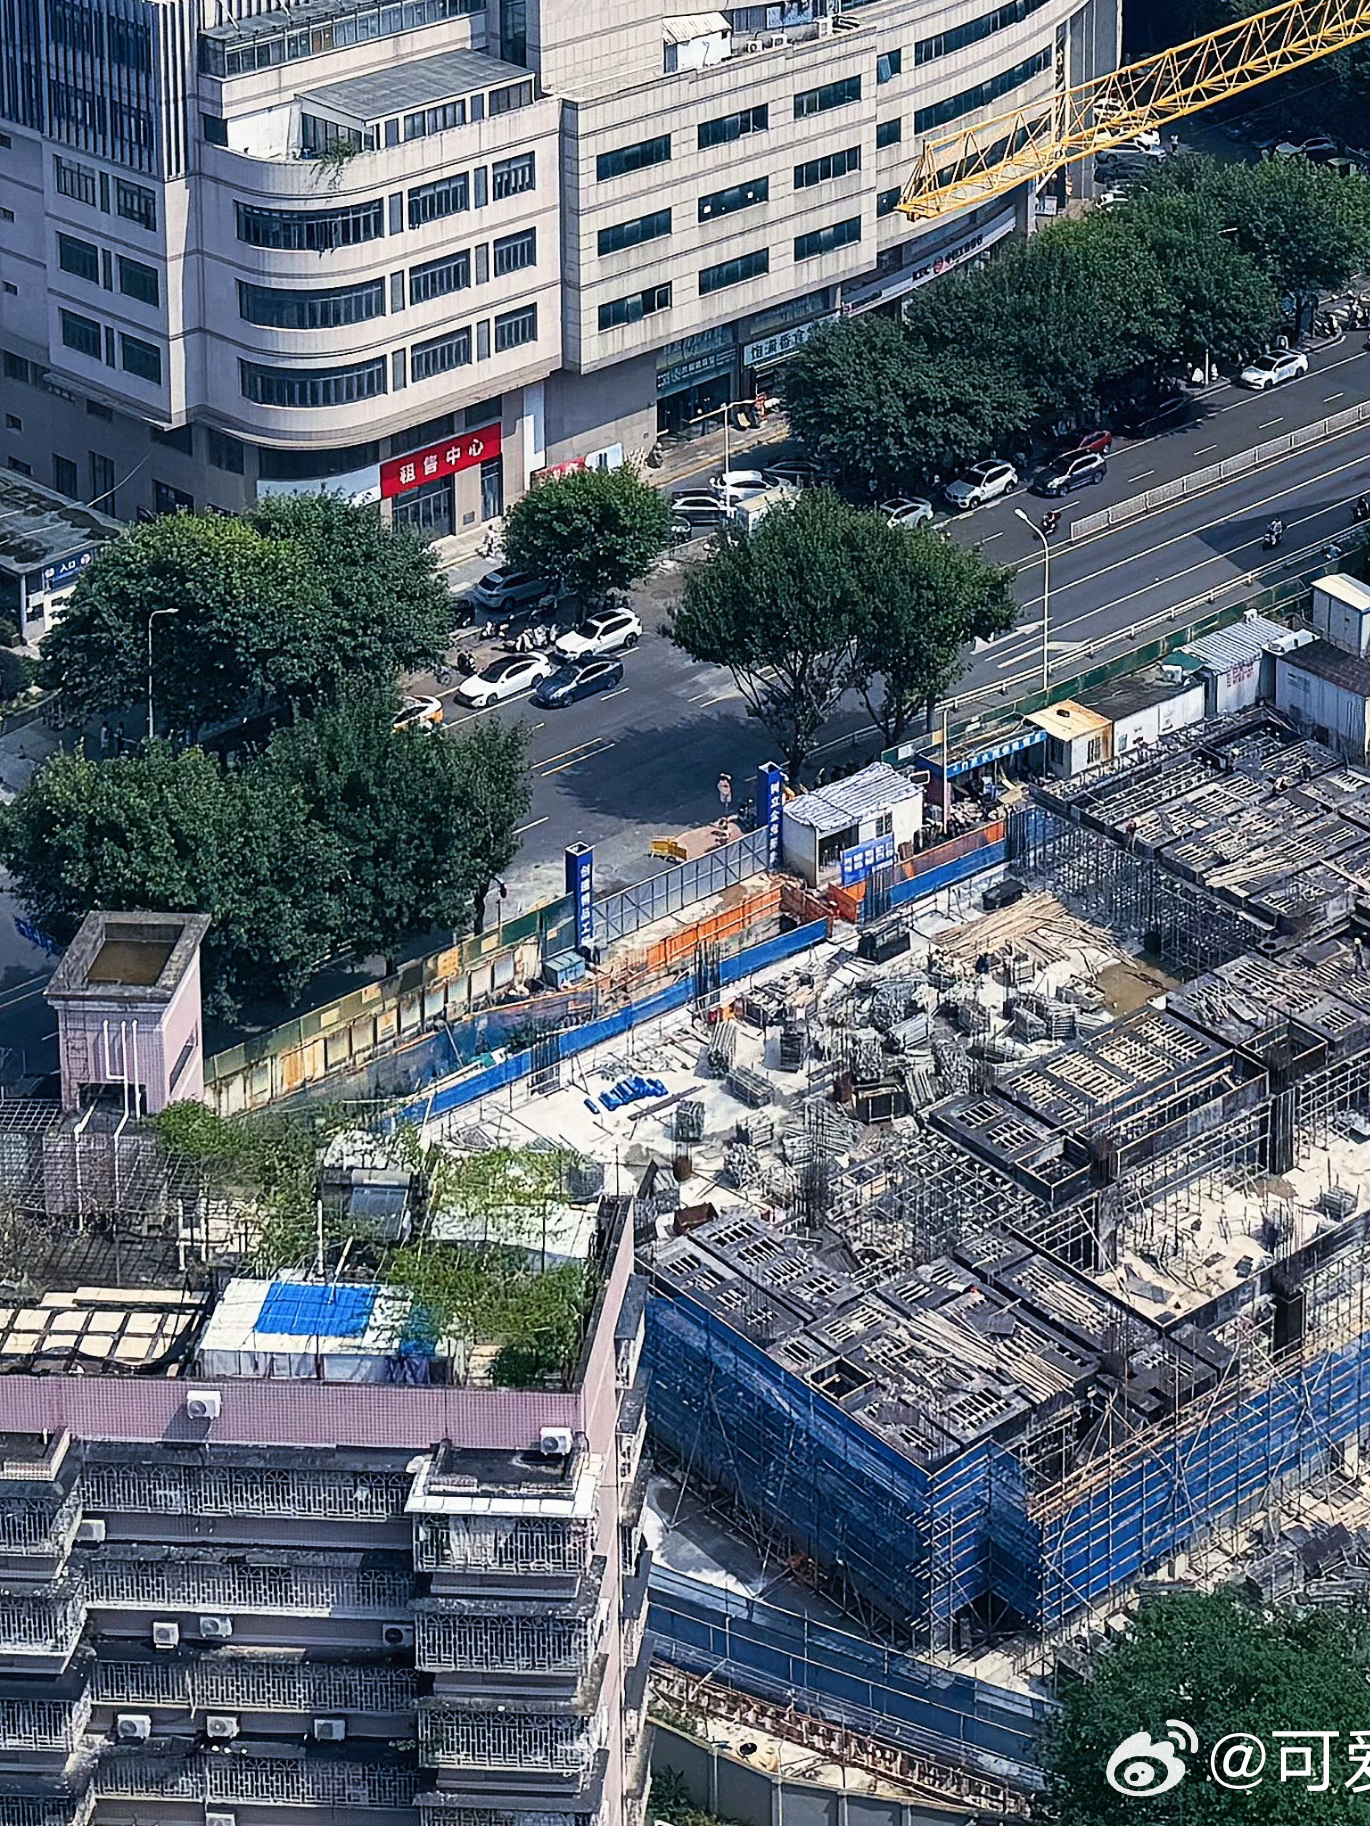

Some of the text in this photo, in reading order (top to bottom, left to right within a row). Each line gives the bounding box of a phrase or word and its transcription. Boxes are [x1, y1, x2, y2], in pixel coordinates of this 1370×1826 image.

[400, 438, 484, 484] 租售中心
[60, 560, 76, 573] 入口
